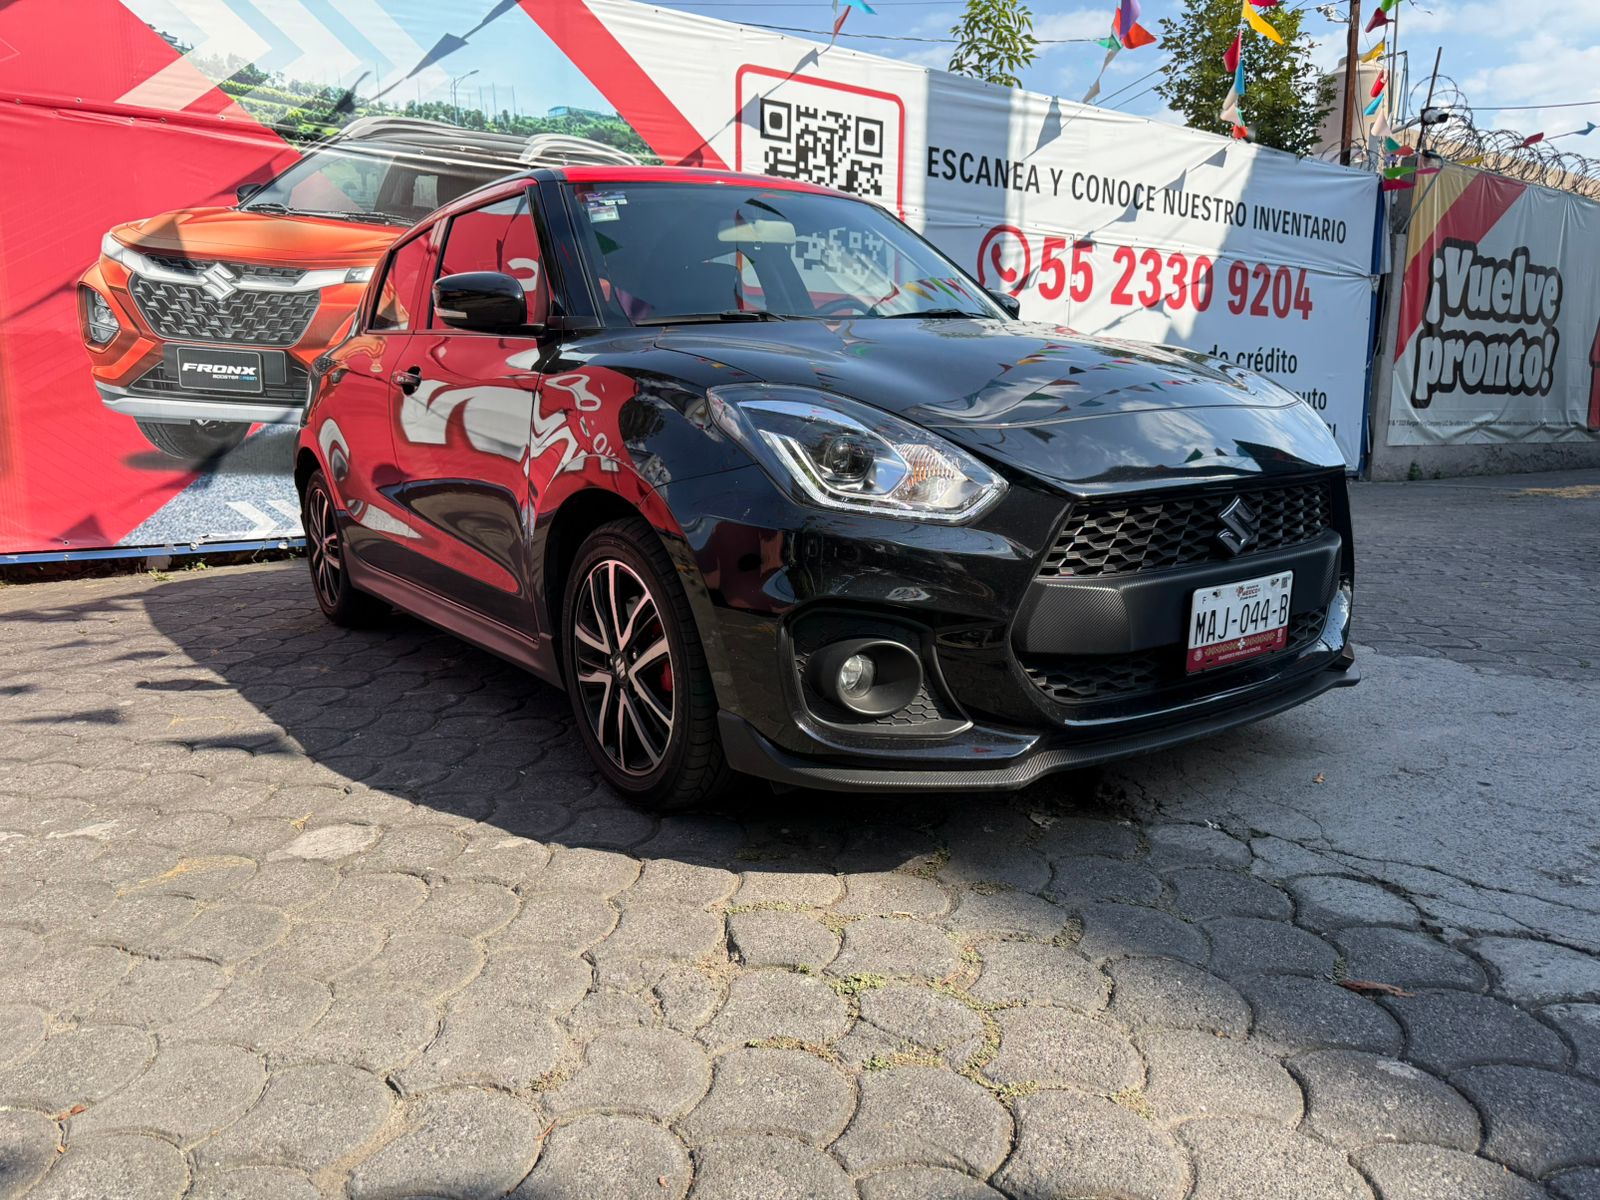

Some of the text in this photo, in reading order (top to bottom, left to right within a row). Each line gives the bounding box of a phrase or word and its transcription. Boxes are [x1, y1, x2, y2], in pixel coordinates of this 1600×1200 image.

[926, 146, 1347, 245] ESCANEA Y CONOCE NUESTRO INVENTARIO
[1038, 236, 1313, 321] 55 2330 9204
[1424, 241, 1561, 325] ¡Vuelve
[182, 362, 257, 375] FRONX
[1236, 346, 1298, 374] crédito
[1413, 331, 1558, 403] pronto!
[1295, 388, 1327, 410] uto
[1194, 593, 1289, 646] MAJ-044-B
